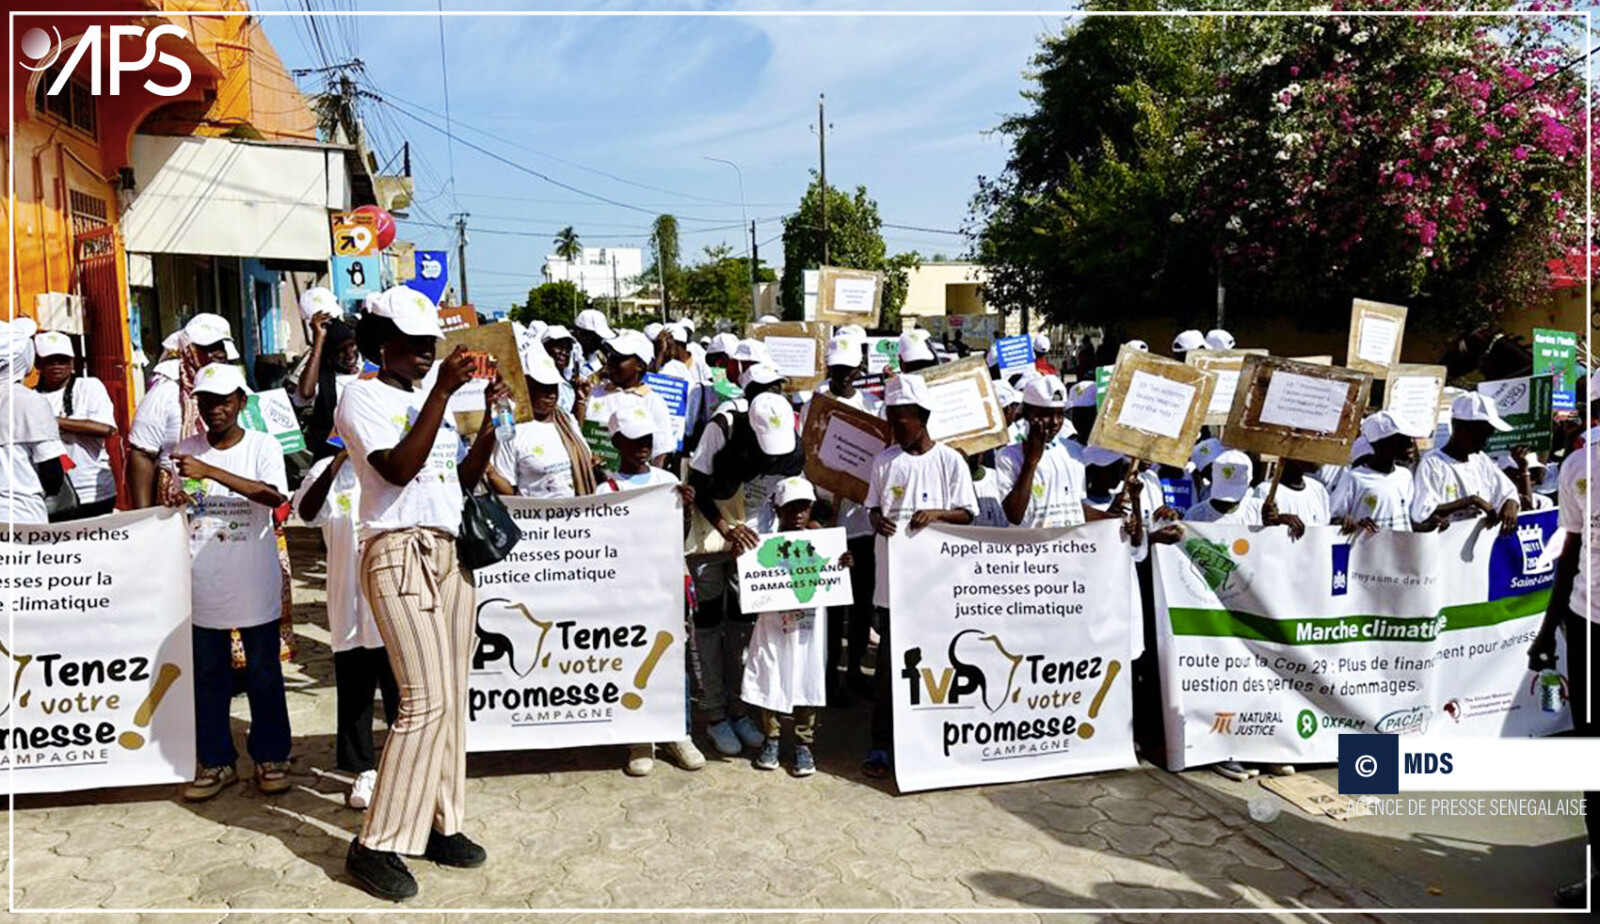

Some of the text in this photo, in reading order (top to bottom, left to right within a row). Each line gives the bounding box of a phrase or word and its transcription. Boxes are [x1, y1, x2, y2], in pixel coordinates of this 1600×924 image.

[513, 503, 629, 522] aux pays riches
[0, 528, 129, 545] ux pays riches
[518, 527, 591, 541] enir leurs
[0, 550, 82, 565] enir leurs
[504, 545, 617, 563] messes pour la
[941, 540, 1097, 558] Appel aux pays riches
[477, 567, 616, 587] justice climatique
[744, 564, 844, 580] ADRESS LOSS AND
[974, 561, 1059, 575] à tenir leurs
[0, 571, 112, 590] esses pour la
[750, 577, 841, 592] DAMAGES NOW!
[1510, 574, 1555, 589] Saint-Lou
[953, 581, 1086, 599] promesses pour la
[12, 595, 110, 612] climatique
[954, 601, 1083, 619] justice climatique
[556, 621, 648, 650] Tenez
[1296, 615, 1448, 642] Marche climatie
[1178, 653, 1220, 668] route
[1274, 657, 1307, 674] Cop
[1311, 660, 1328, 675] 29
[1338, 658, 1368, 672] Plus
[1371, 657, 1389, 671] de
[1469, 641, 1498, 659] pour
[1500, 631, 1537, 650] adress
[36, 653, 149, 687] Tenez
[559, 656, 623, 675] votre
[1027, 654, 1102, 685] Tenez
[1182, 676, 1420, 697] uestion des pertes et dommages.
[41, 692, 120, 714] votre
[1027, 689, 1082, 710] votre
[511, 708, 613, 722] CAMPAGNE
[1238, 712, 1283, 724] NATURAL
[1321, 715, 1366, 730] OXFAM
[1234, 724, 1276, 737] JUSTICE
[0, 749, 108, 765] AMPAGNE
[982, 739, 1070, 757] CAMPAGNE
